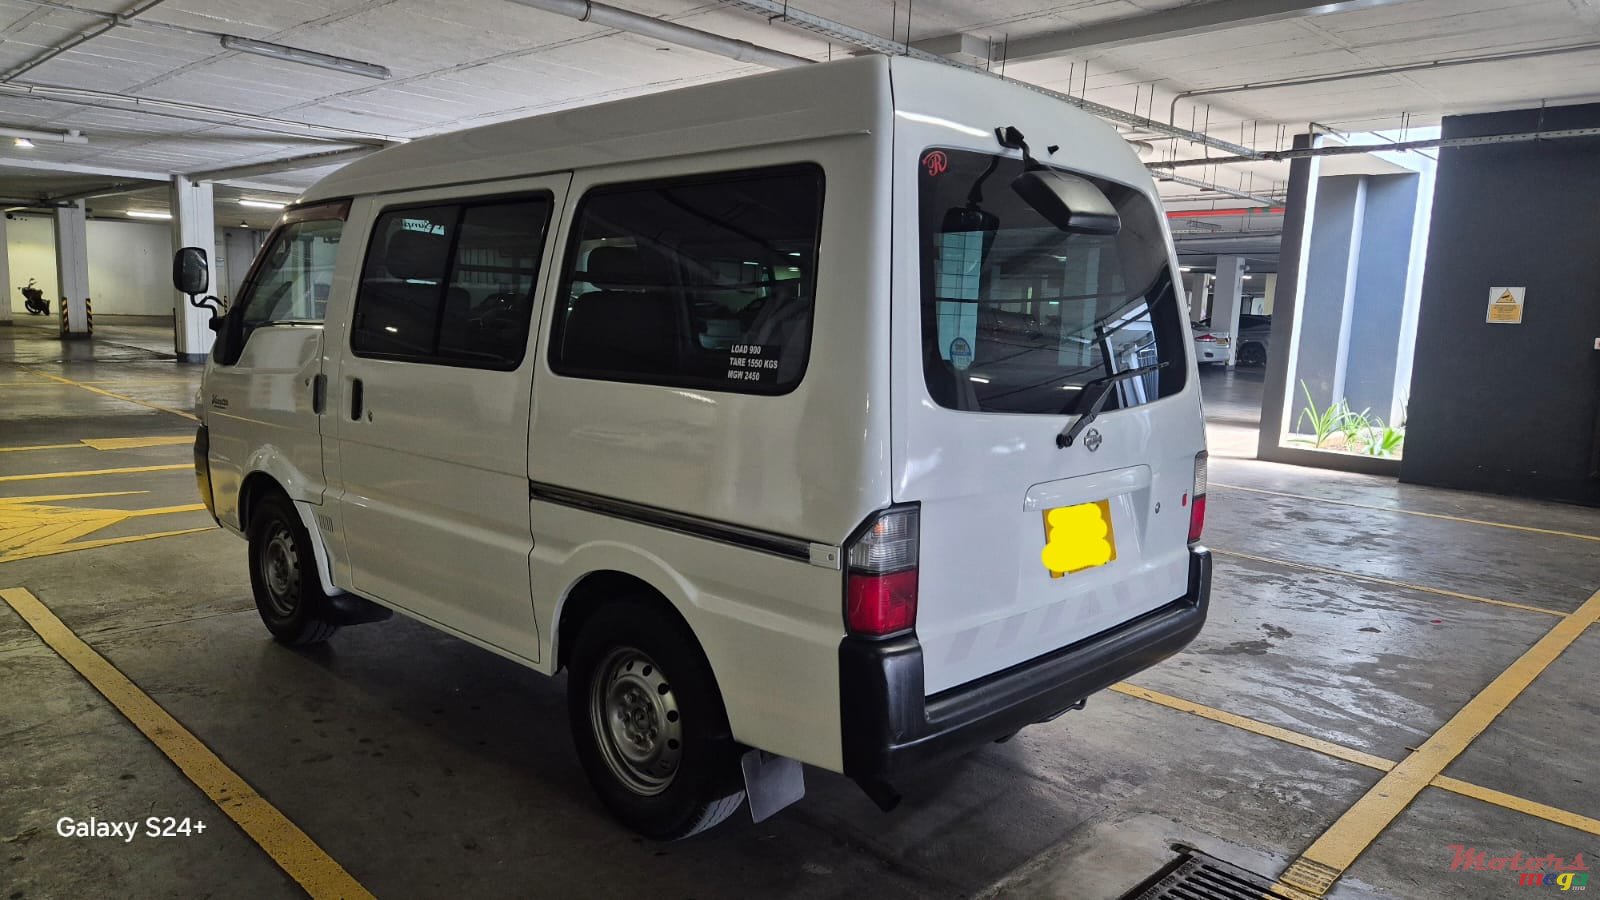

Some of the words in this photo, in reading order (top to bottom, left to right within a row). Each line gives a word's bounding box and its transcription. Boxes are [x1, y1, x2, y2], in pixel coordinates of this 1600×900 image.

[731, 344, 748, 354] LOAD
[749, 345, 762, 355] 900
[730, 357, 746, 367] TARE
[747, 359, 763, 368] 1550
[763, 360, 779, 369] KGS
[727, 370, 744, 380] MGW
[744, 371, 760, 381] 2450
